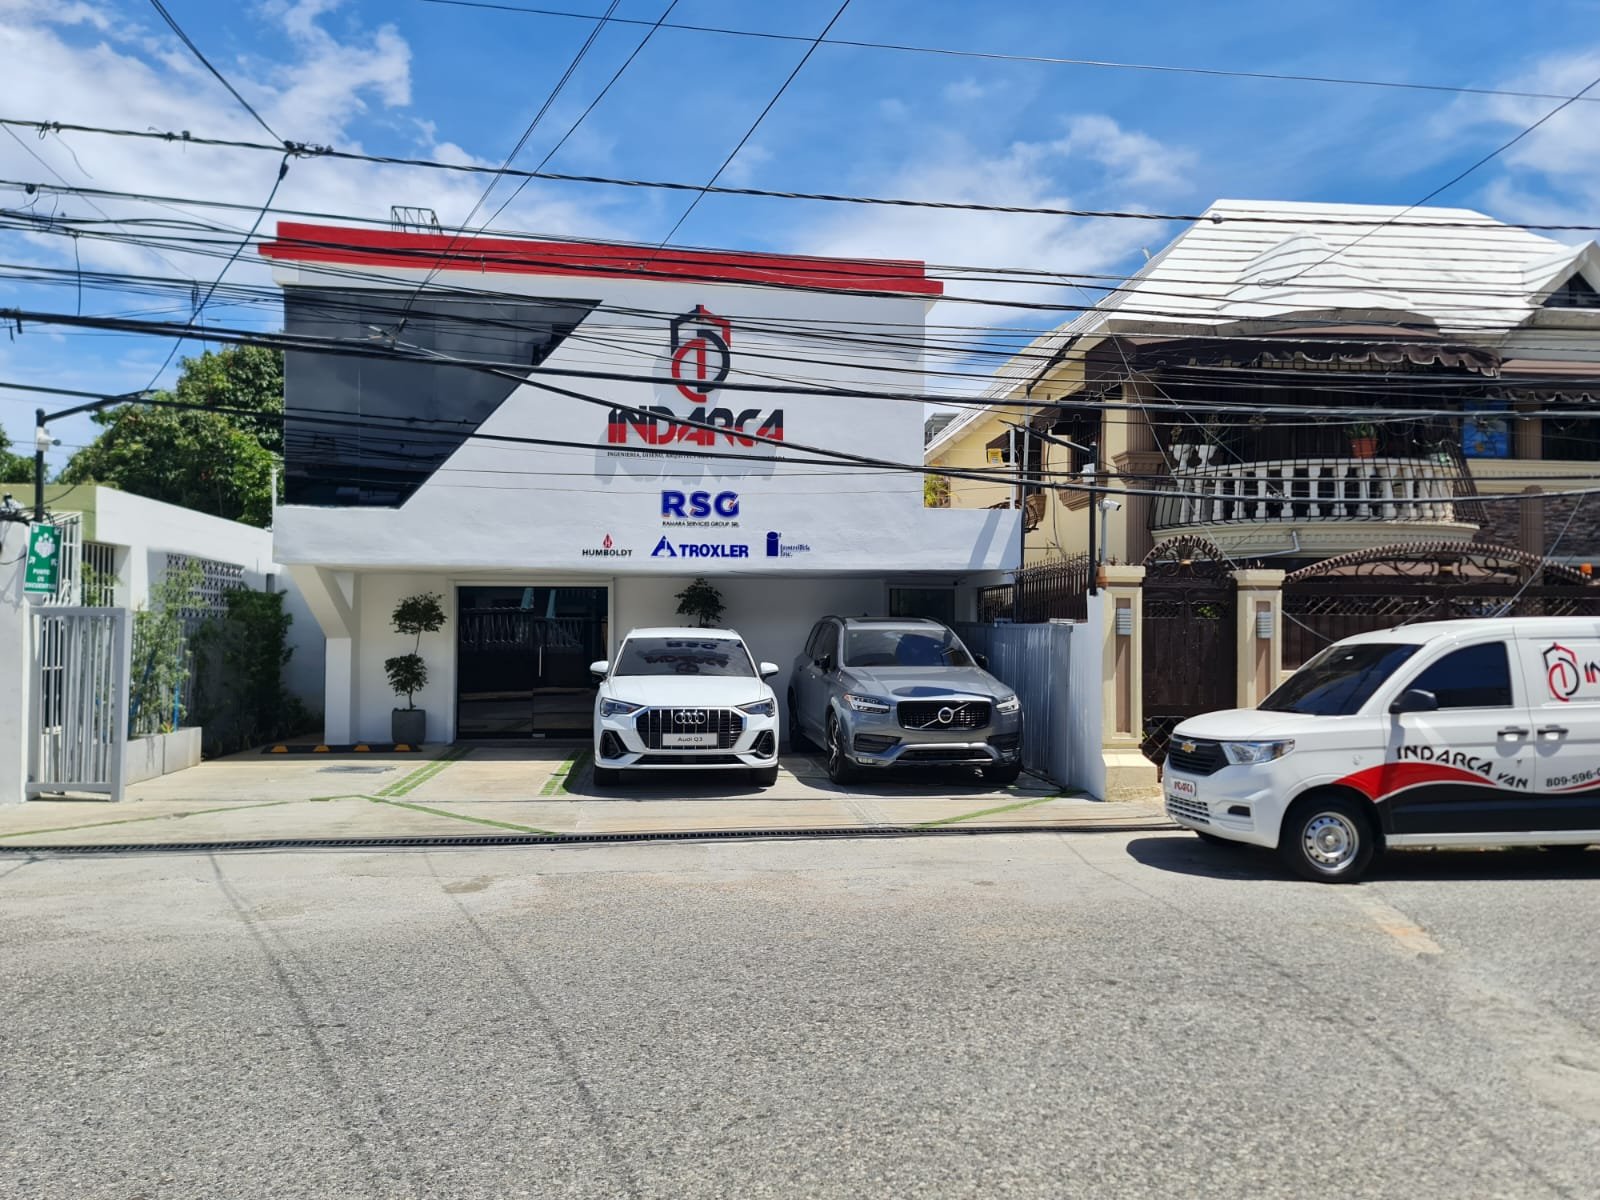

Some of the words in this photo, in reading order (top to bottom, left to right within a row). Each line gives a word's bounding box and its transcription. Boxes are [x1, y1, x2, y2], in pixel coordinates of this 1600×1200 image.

[608, 406, 784, 447] INDARCA
[662, 490, 739, 518] RSG
[679, 543, 749, 558] TROXLER
[1396, 745, 1493, 777] INDARCA
[1496, 771, 1529, 790] VAN
